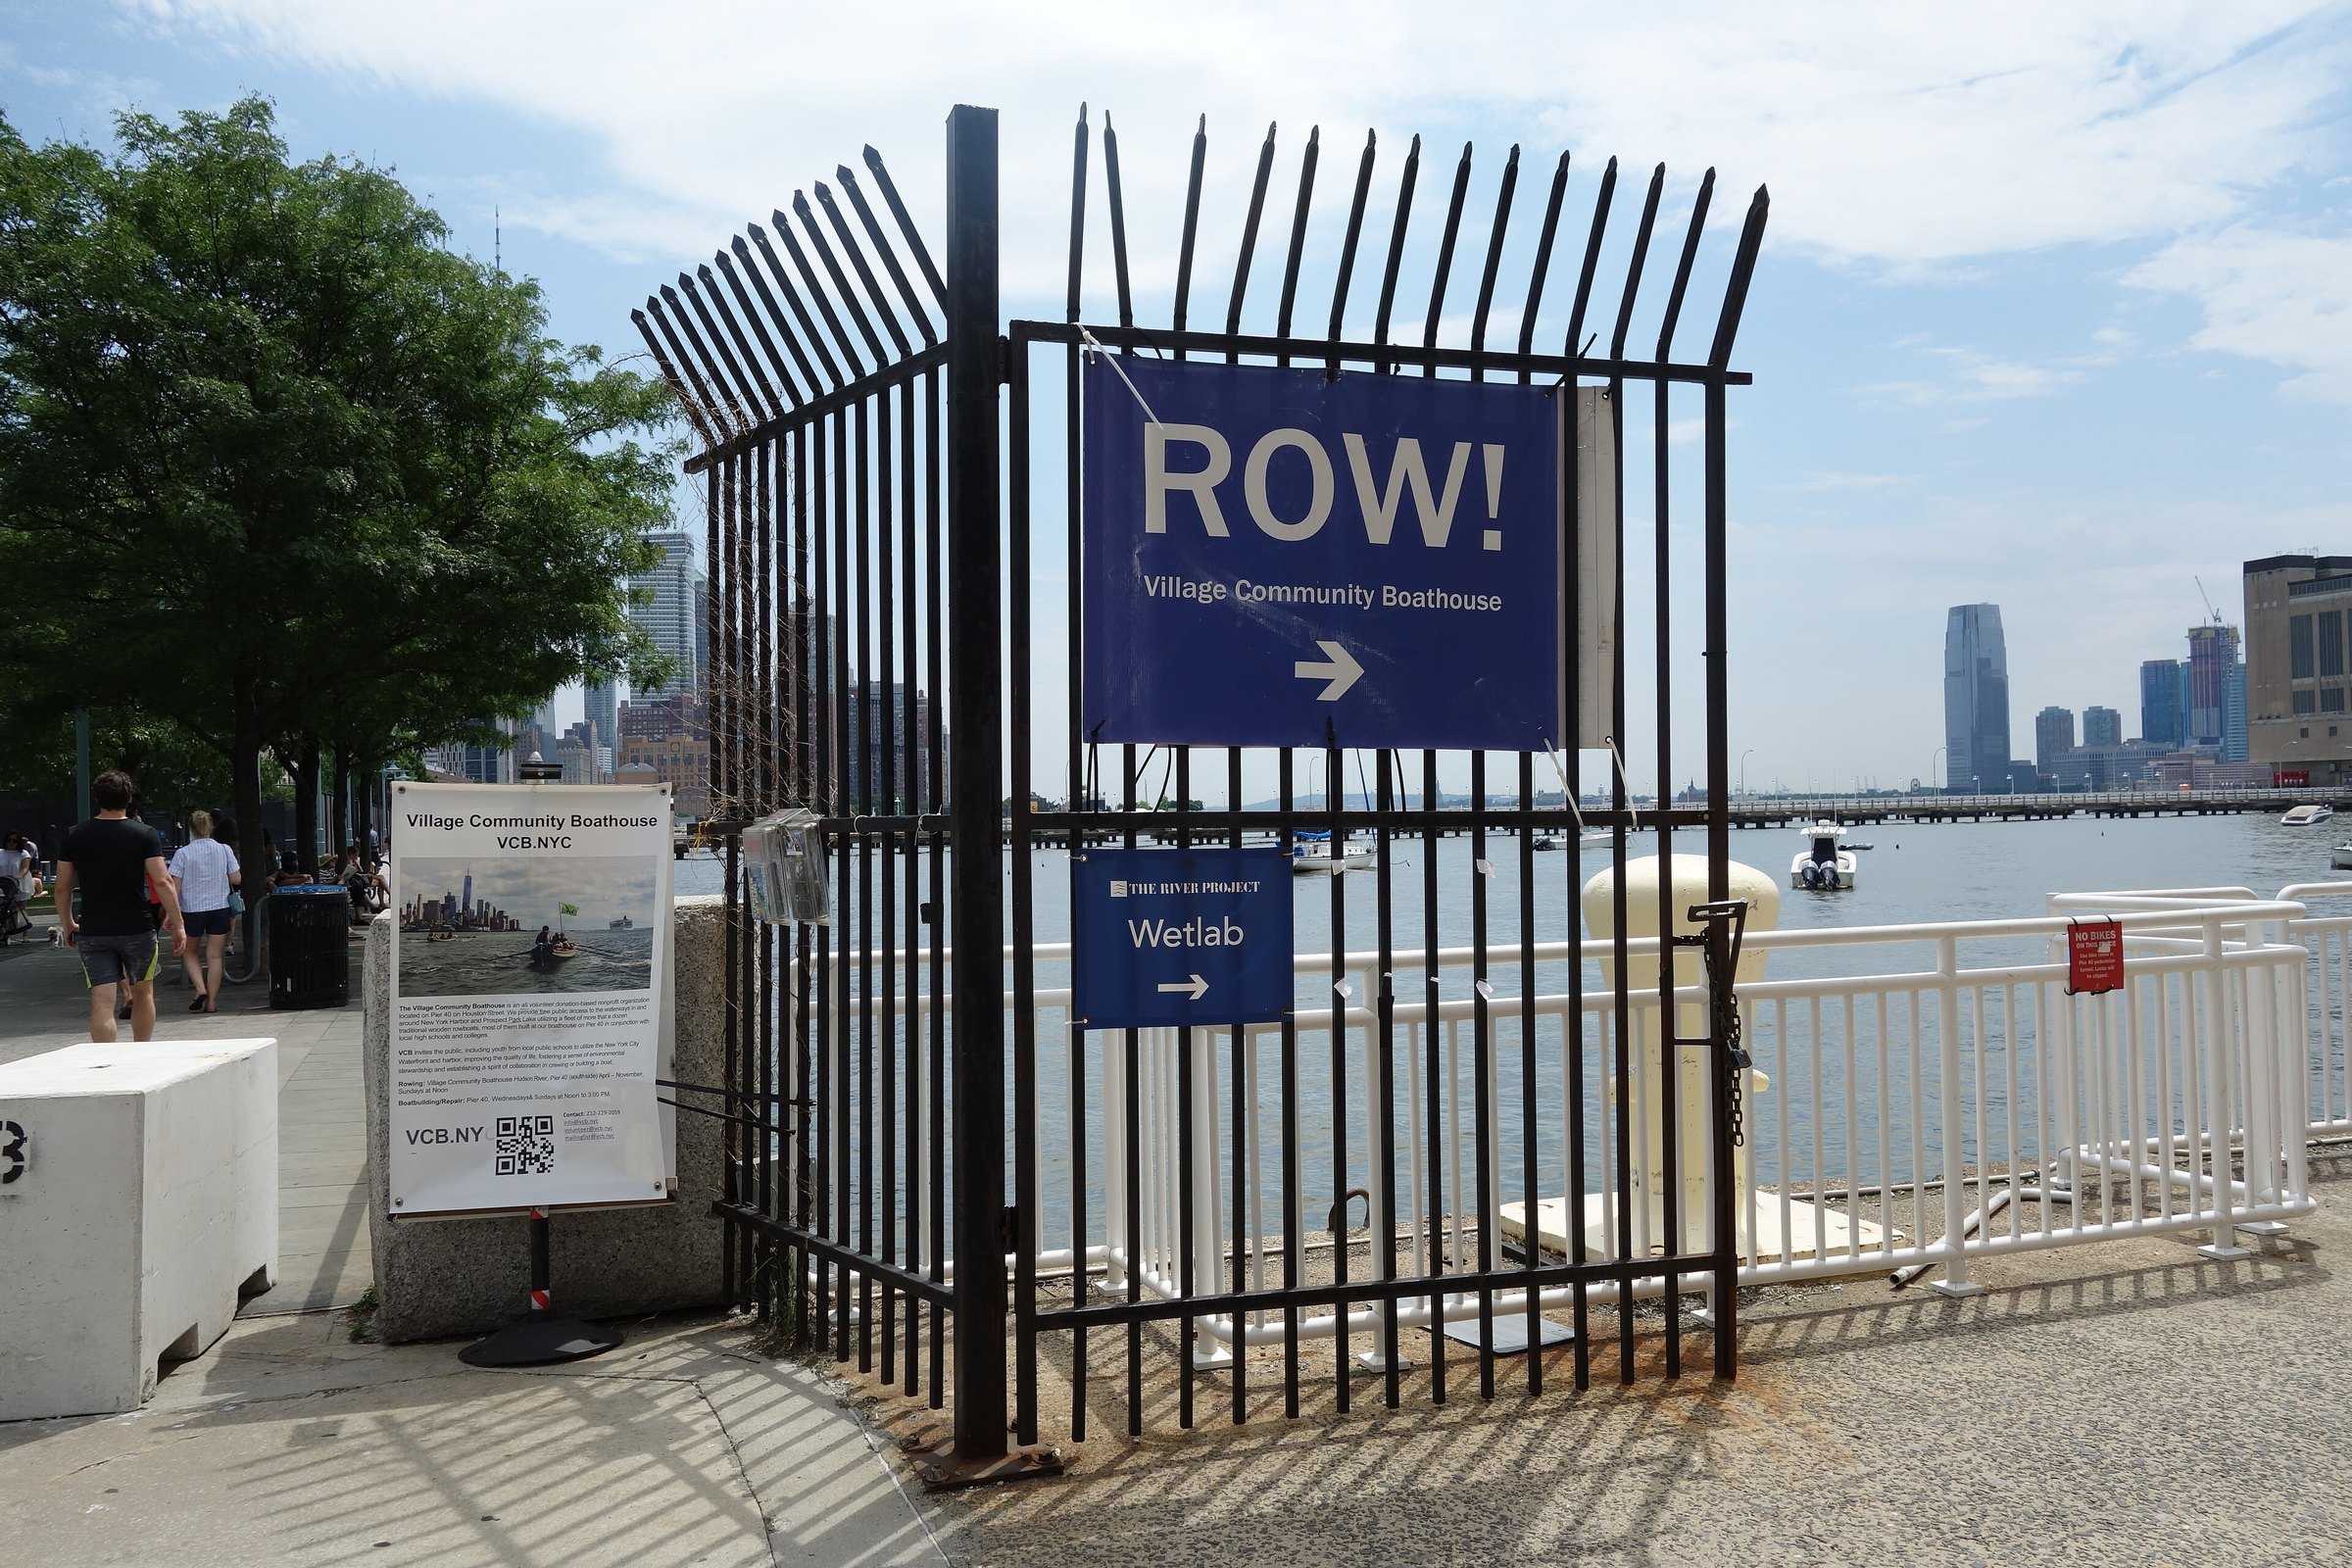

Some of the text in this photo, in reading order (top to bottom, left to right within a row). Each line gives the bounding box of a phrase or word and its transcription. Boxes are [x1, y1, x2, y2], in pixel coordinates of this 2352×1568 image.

[1144, 422, 1505, 551] ROW!
[1144, 575, 1502, 612] Village Community Boathouse
[407, 813, 658, 830] Village Community Boathouse
[497, 836, 571, 849] VCB.NYC
[1128, 881, 1260, 895] THE RIVER PROJECT
[1128, 915, 1245, 948] Wetlab
[2076, 930, 2116, 941] NO BIKES
[598, 998, 619, 1006] nonprofit
[620, 997, 650, 1005] organization
[604, 1004, 630, 1013] waterways
[452, 1024, 481, 1033] rowboats,
[611, 1018, 638, 1027] conjunction
[465, 1047, 490, 1055] including
[464, 1055, 491, 1064] improving
[398, 1066, 432, 1075] stewardship
[447, 1064, 481, 1073] establishing
[549, 1060, 568, 1069] crewing
[448, 1077, 481, 1087] Community
[568, 1072, 599, 1081] (southside)
[398, 1098, 465, 1107] Boatbuilding/Repair:
[534, 1093, 557, 1102] Sundays
